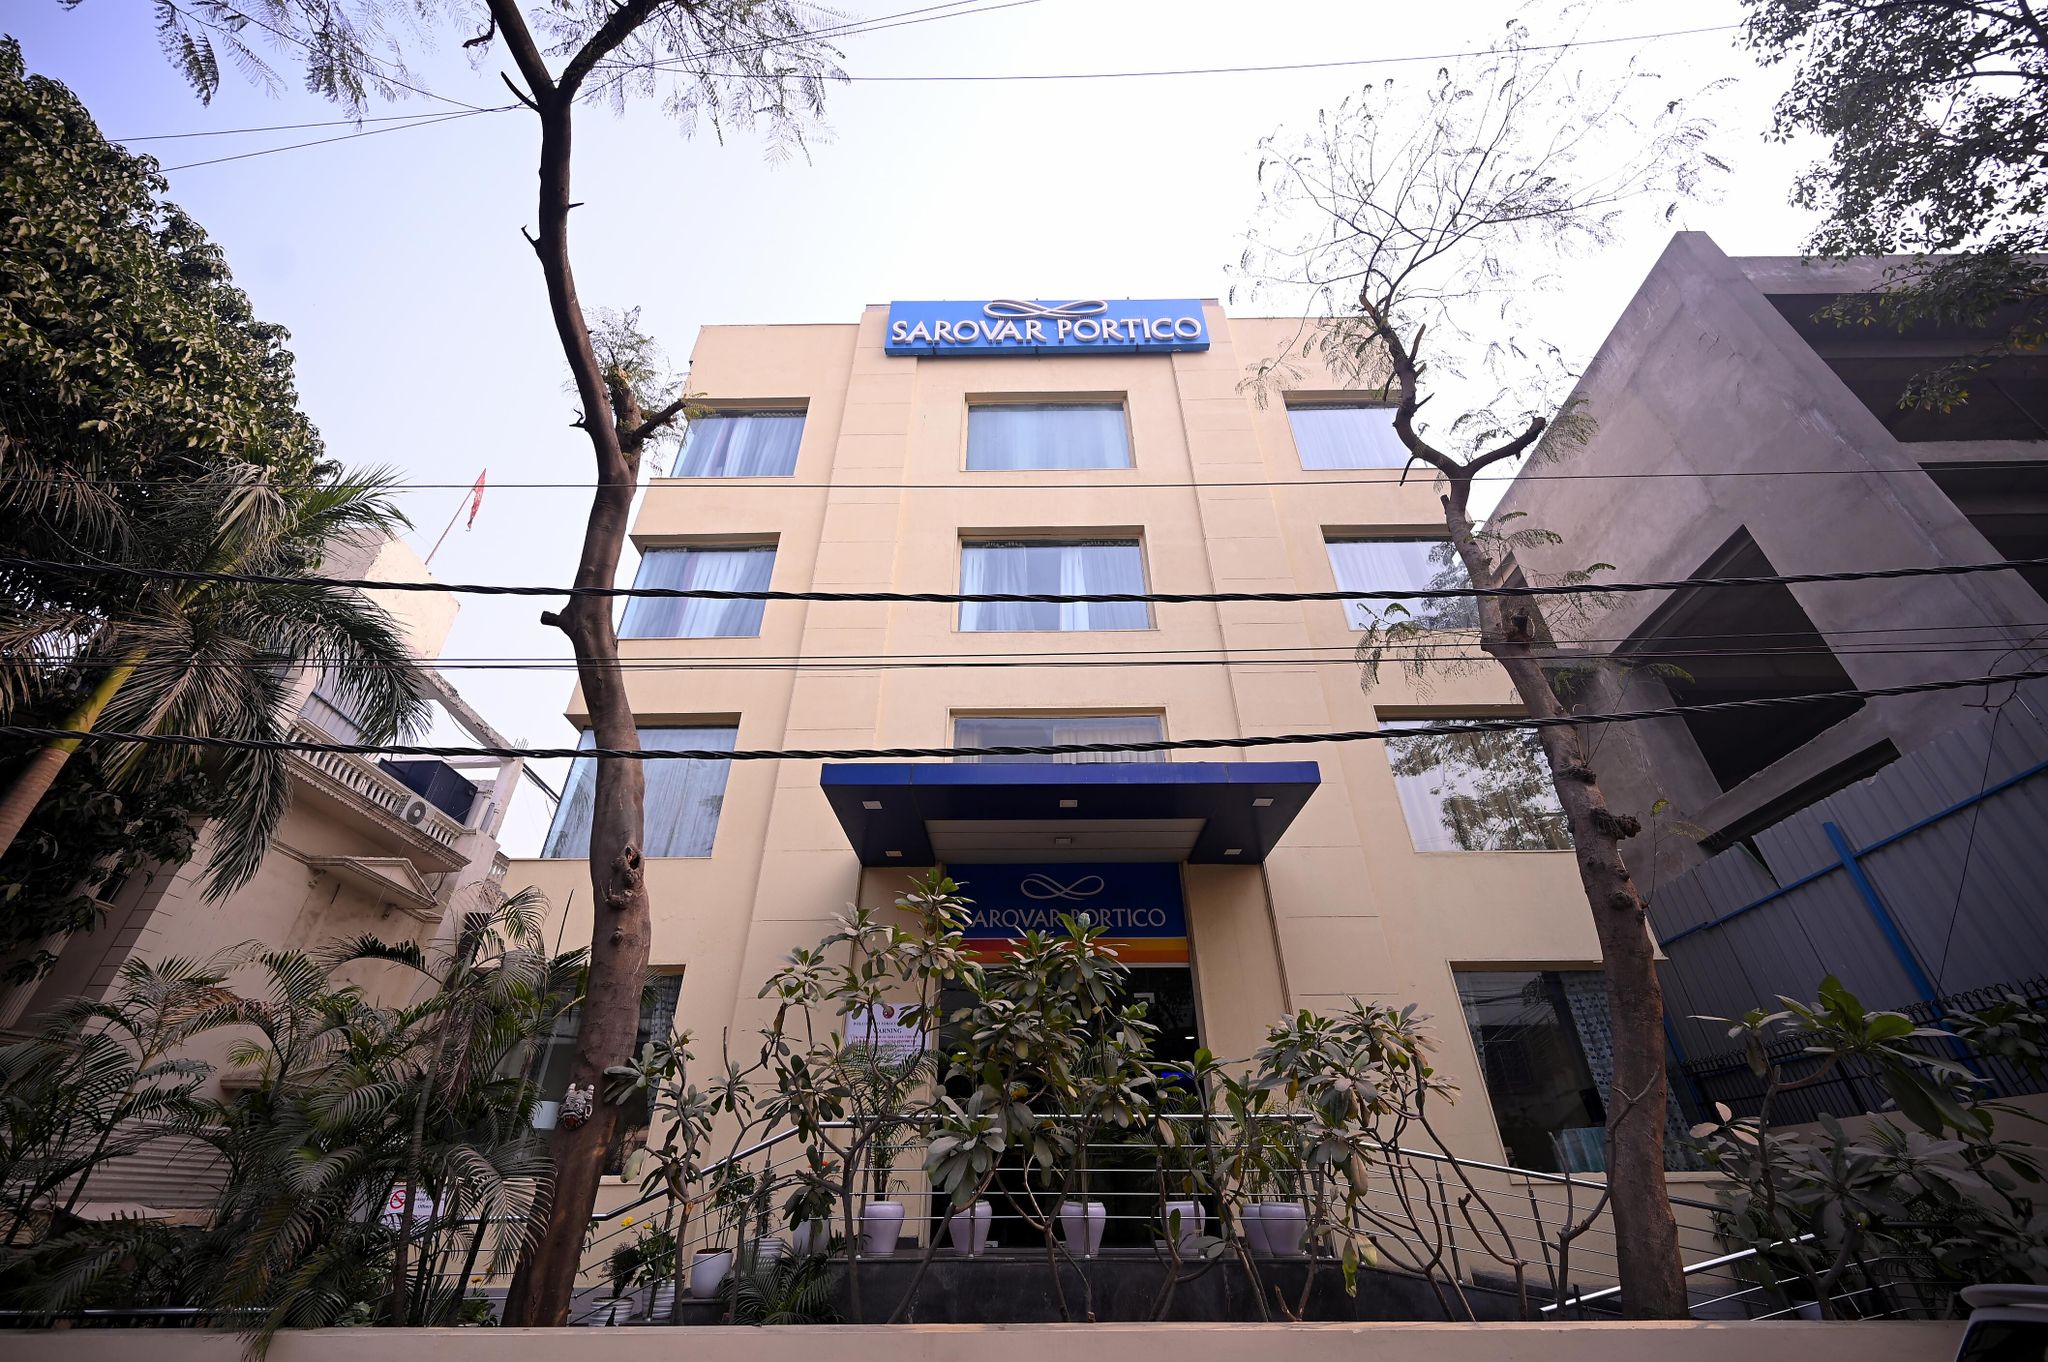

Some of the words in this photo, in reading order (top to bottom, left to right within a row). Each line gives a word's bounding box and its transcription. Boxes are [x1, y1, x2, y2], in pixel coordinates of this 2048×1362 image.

[891, 319, 1047, 344] SAROVAR
[1058, 318, 1202, 343] PORTICO
[1071, 908, 1167, 928] PORTICO
